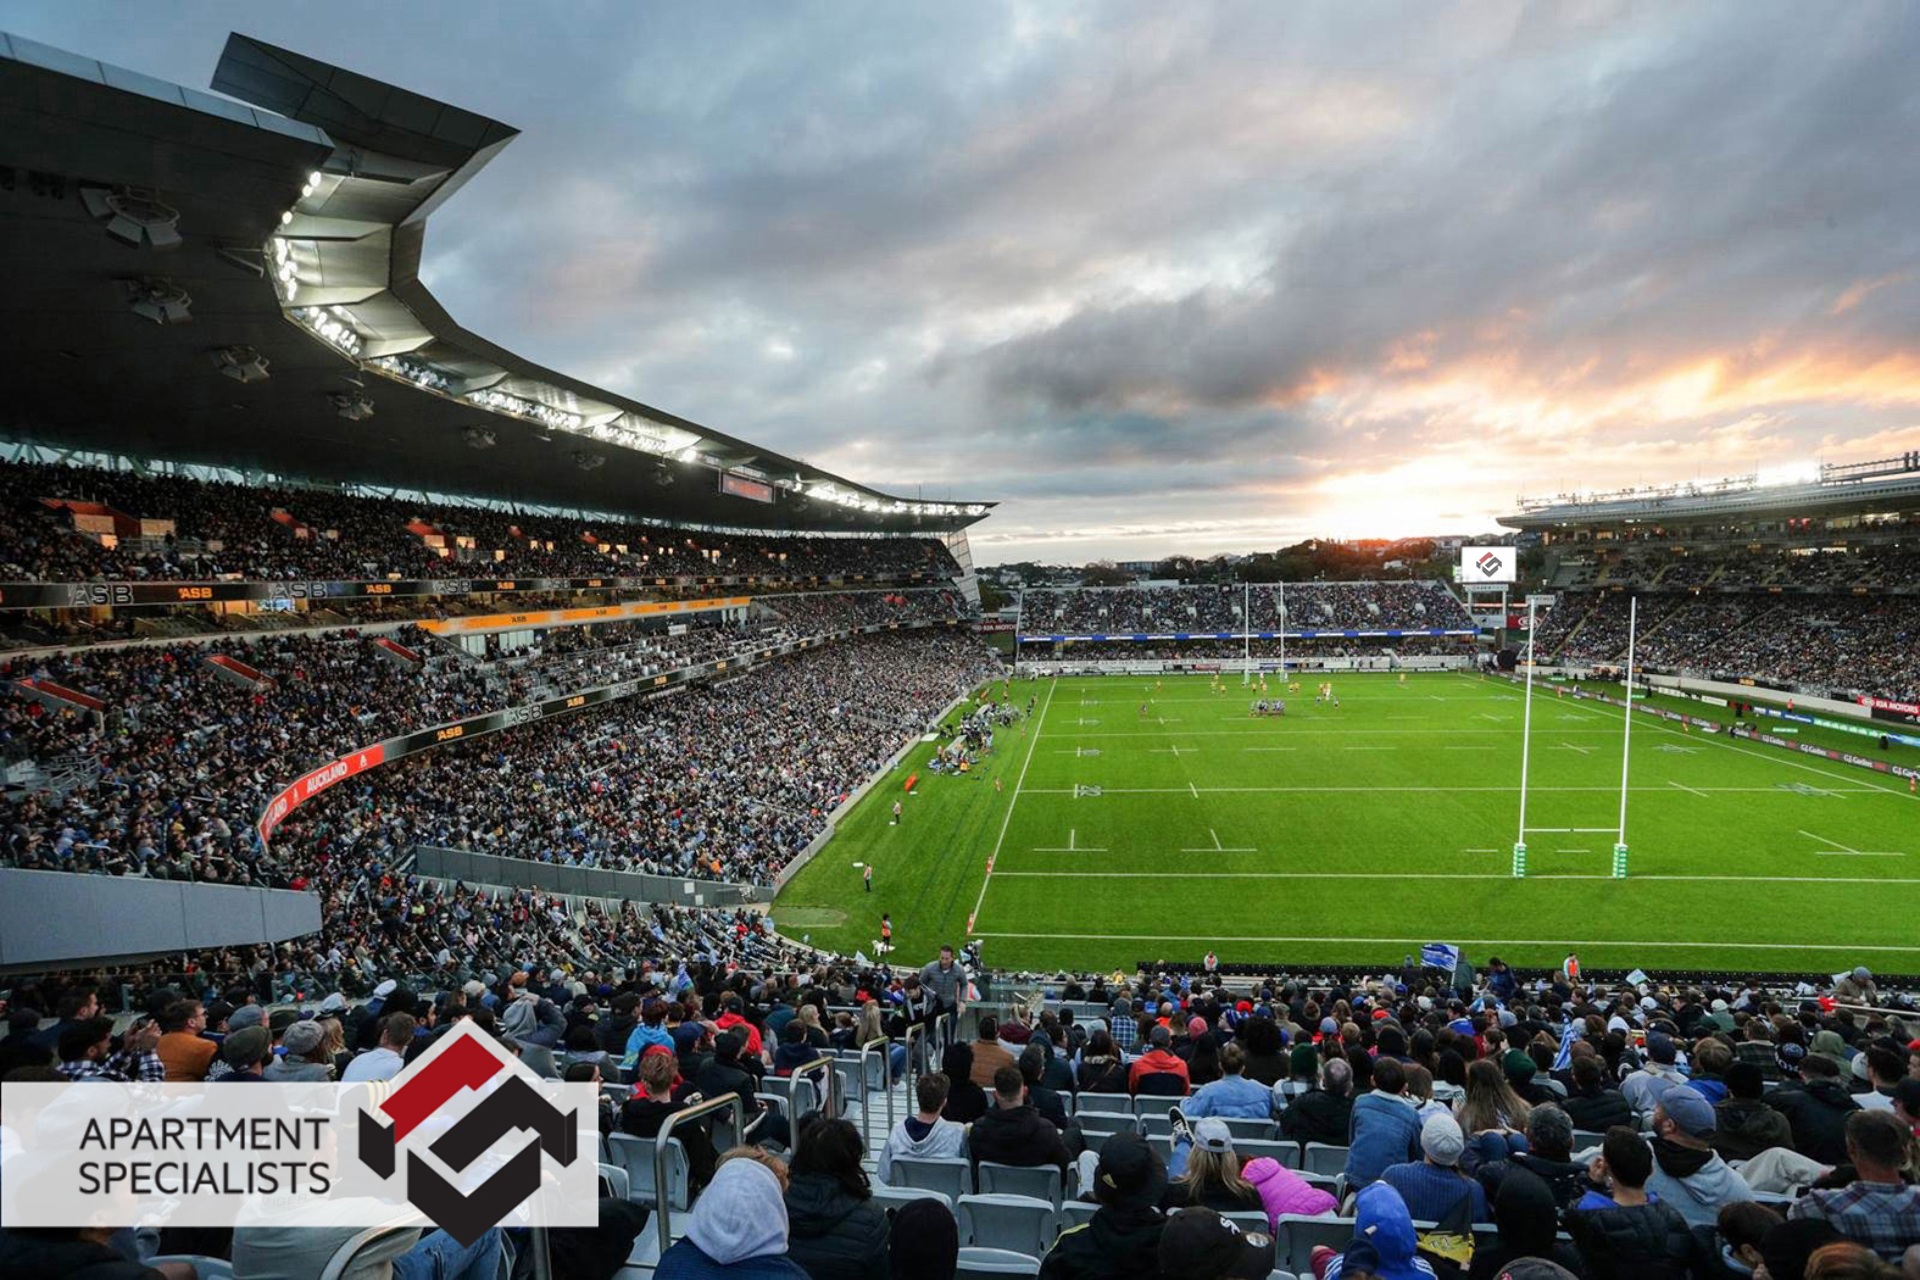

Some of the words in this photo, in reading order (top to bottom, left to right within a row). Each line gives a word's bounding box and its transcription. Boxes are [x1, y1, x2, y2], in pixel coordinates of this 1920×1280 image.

[68, 583, 134, 607] ASB
[178, 587, 213, 600] ASB
[268, 581, 328, 600] ASB
[367, 583, 392, 594] ASB
[438, 725, 464, 741] ASB
[306, 761, 348, 794] AUCKLAND
